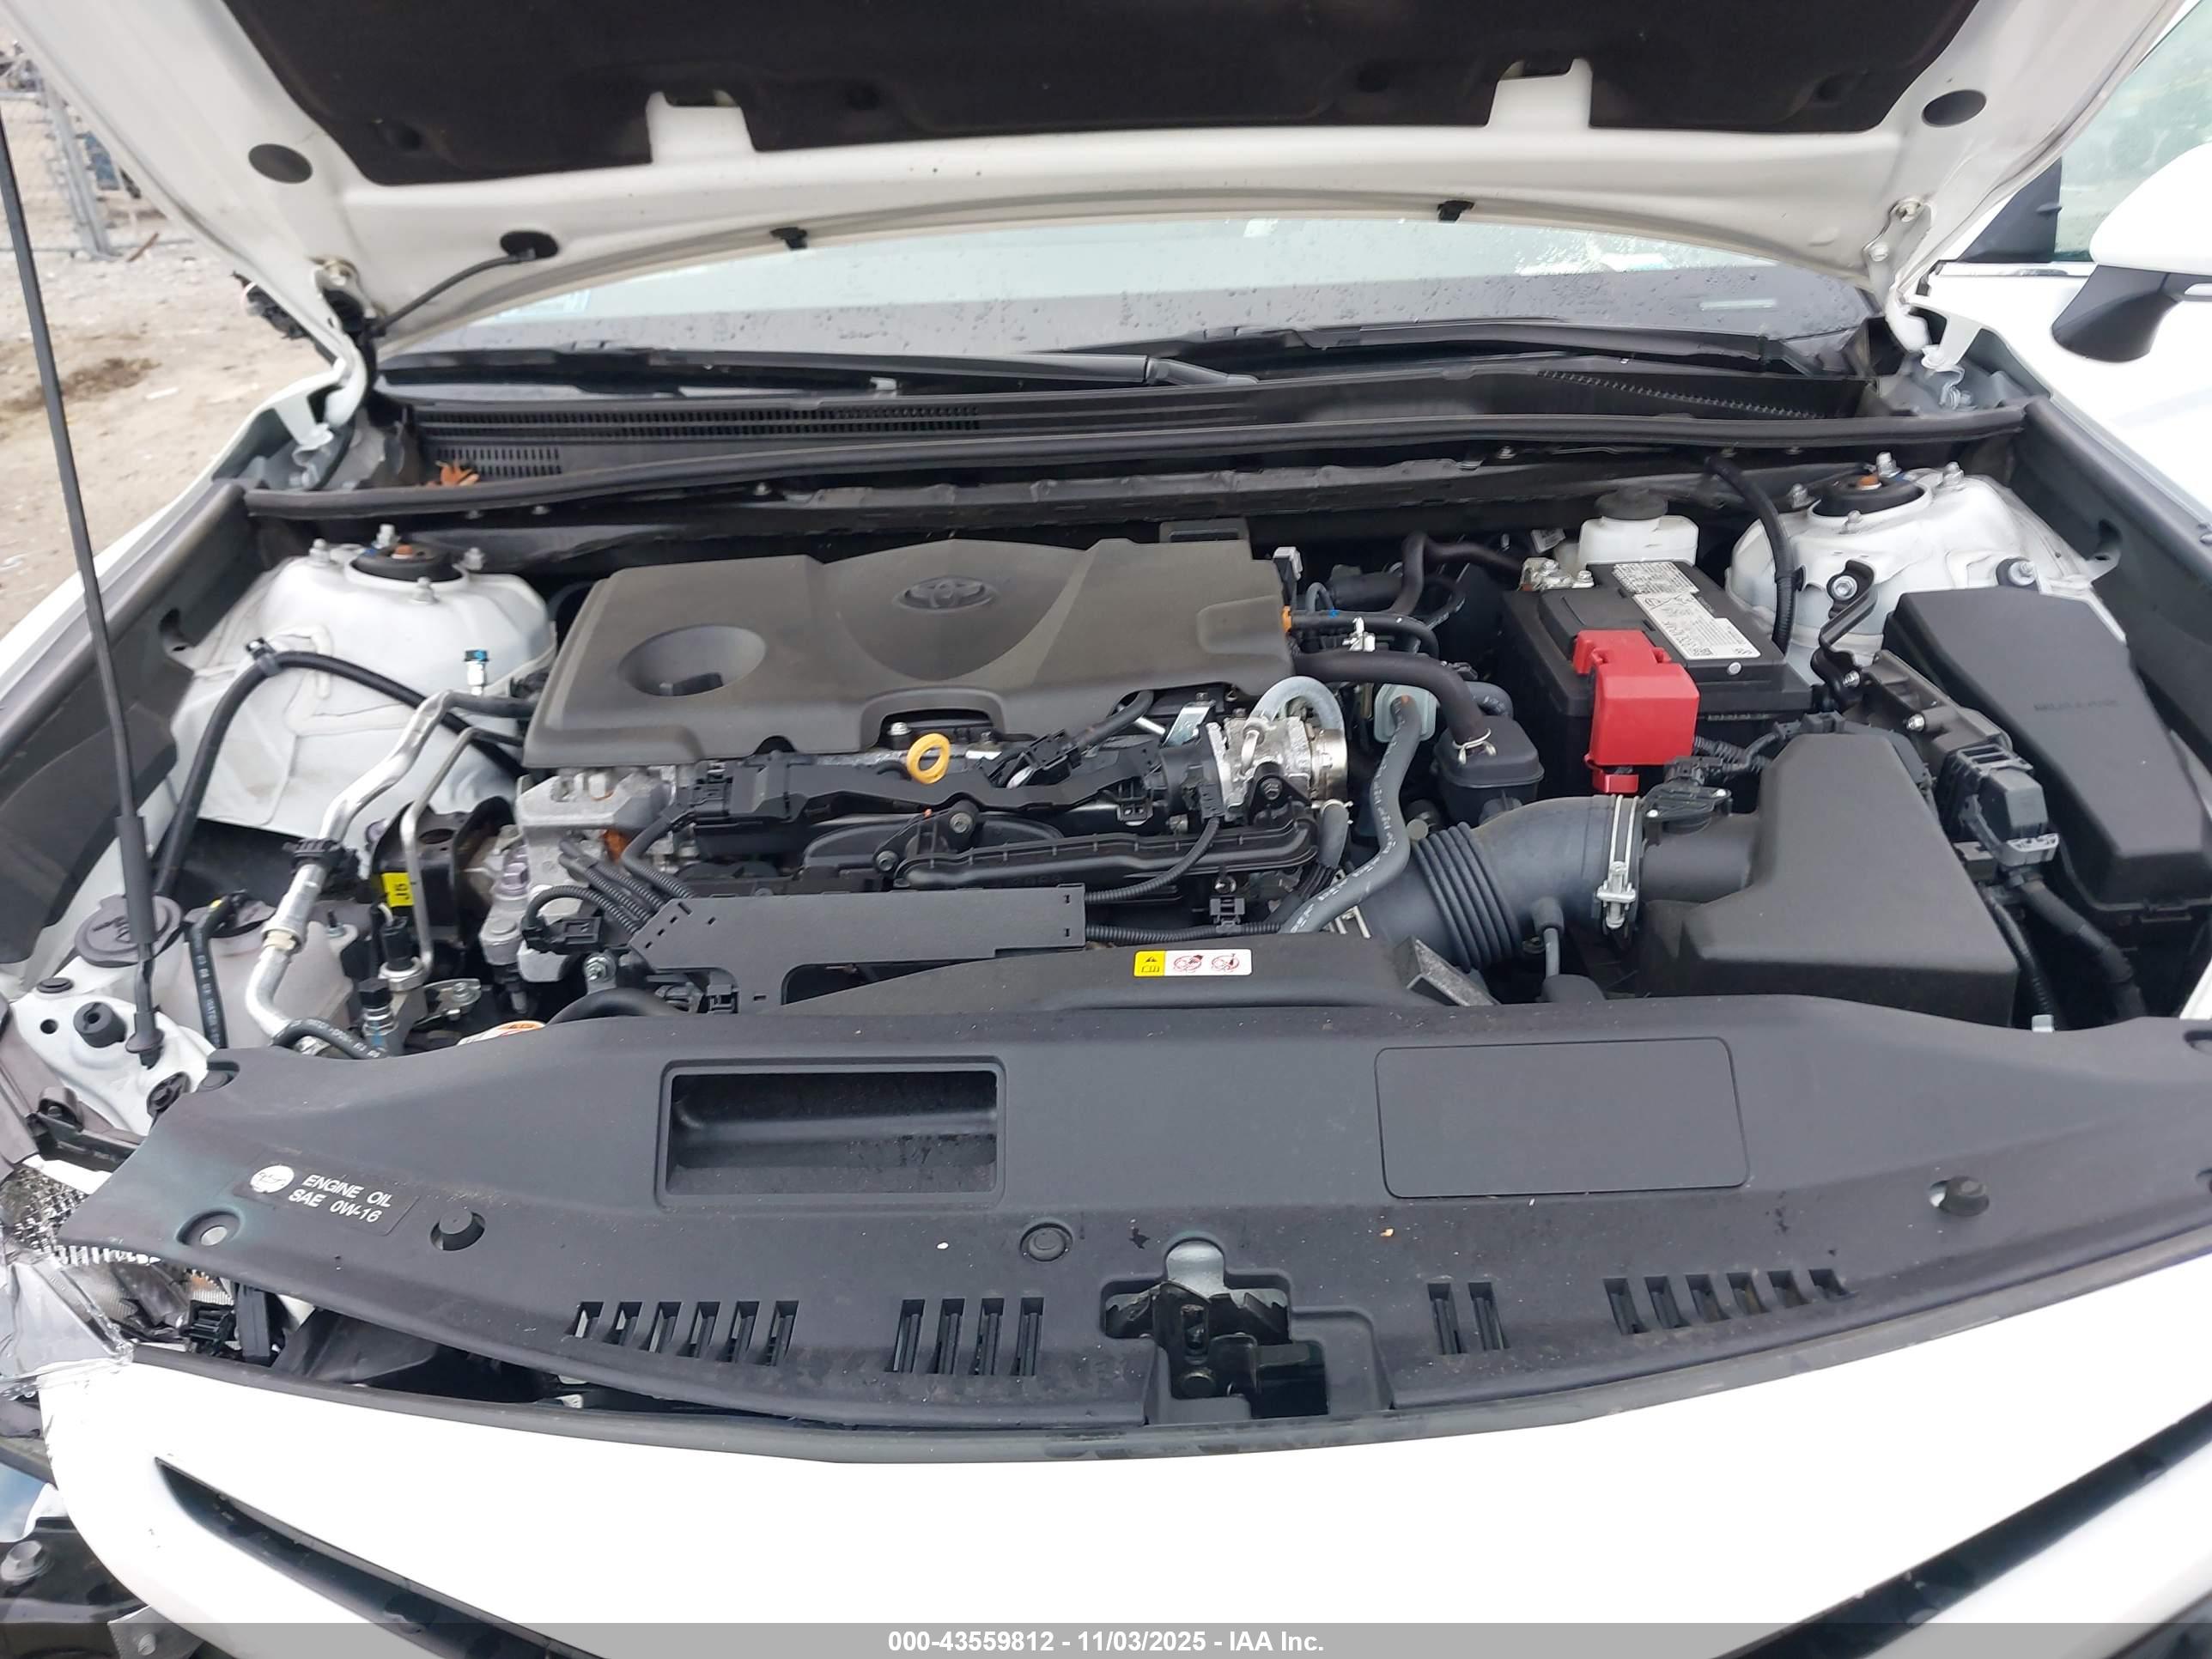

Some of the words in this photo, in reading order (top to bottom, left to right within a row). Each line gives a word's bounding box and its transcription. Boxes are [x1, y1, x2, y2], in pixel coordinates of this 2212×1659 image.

[289, 1188, 326, 1208] SAE
[330, 1200, 383, 1223] 0W-16
[302, 1173, 364, 1199] ENGINE
[367, 1190, 392, 1208] OIL
